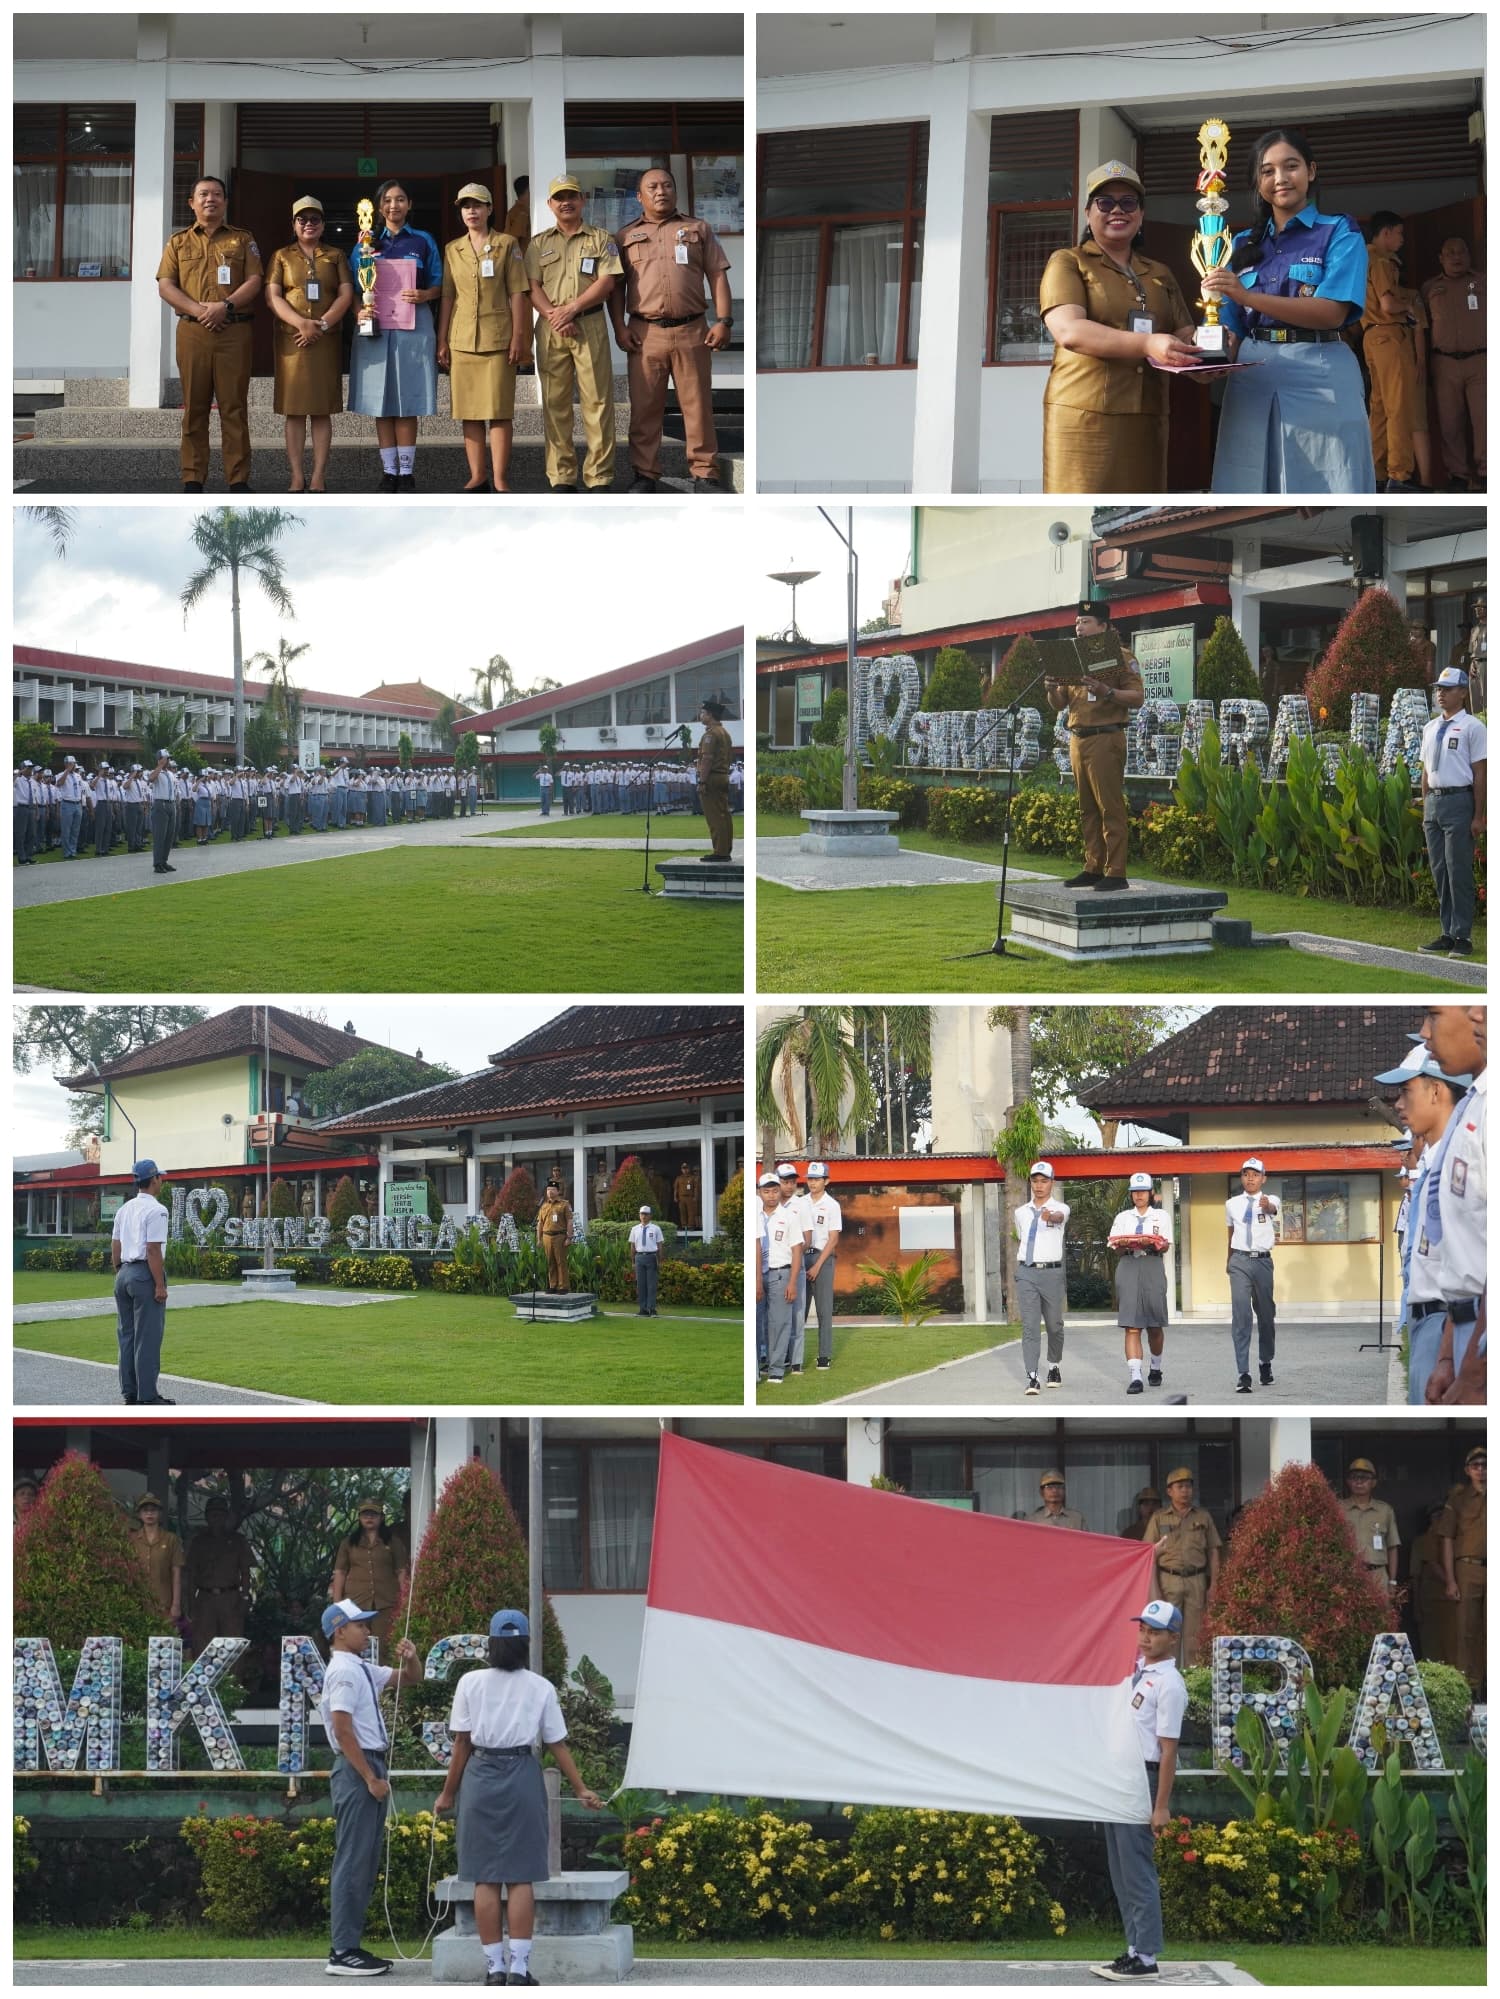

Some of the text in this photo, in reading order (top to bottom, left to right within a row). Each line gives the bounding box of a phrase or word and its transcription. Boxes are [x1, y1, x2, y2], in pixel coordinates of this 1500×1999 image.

[1145, 656, 1170, 670] BERSIH
[1144, 671, 1170, 684] TERTIB
[1144, 686, 1173, 699] DISIPLIN
